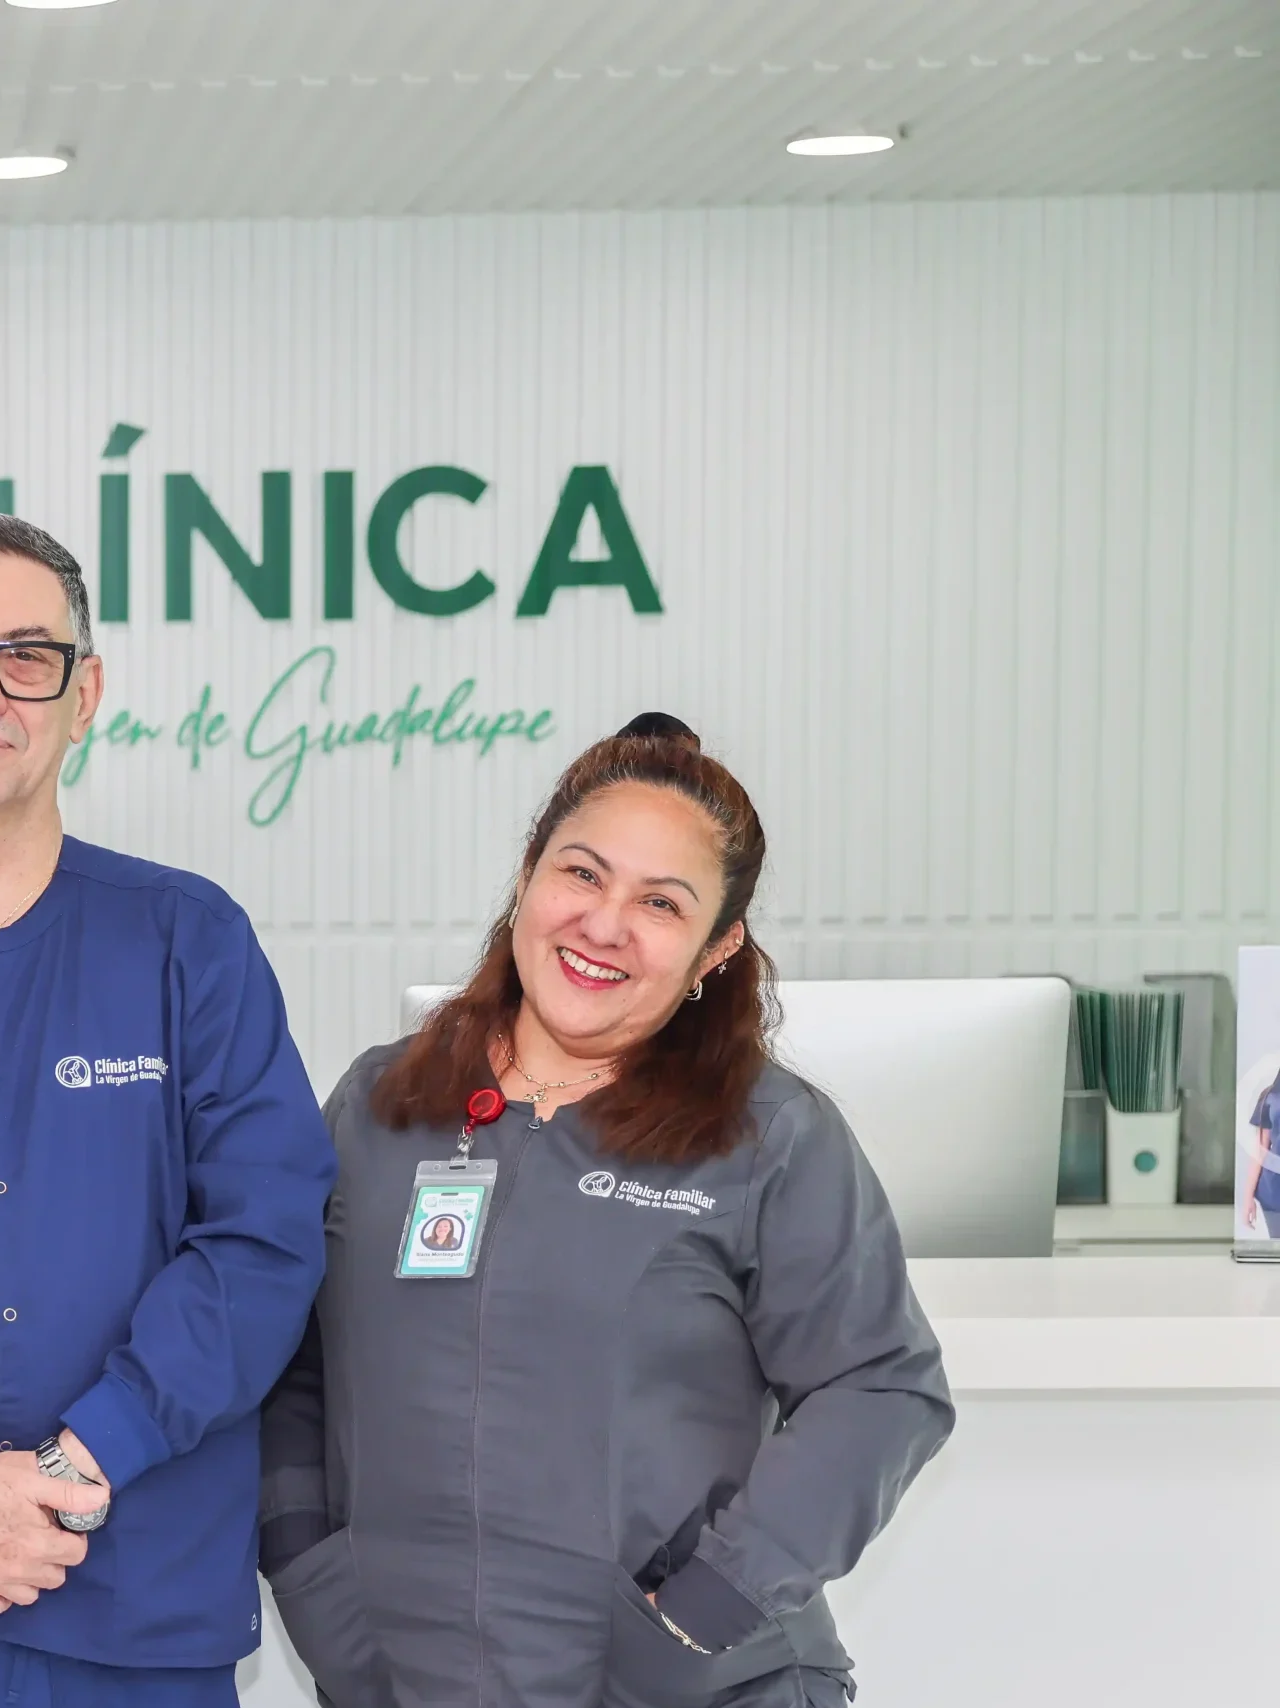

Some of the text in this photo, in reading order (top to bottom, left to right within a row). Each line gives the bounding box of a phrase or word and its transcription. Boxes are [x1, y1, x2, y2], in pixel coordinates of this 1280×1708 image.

[177, 683, 229, 769] de
[245, 645, 555, 826] Guadalupe
[95, 1058, 136, 1074] Clínica
[95, 1075, 104, 1084] La
[105, 1075, 128, 1086] Virgen
[130, 1073, 138, 1082] de
[614, 1191, 700, 1215] La Virgen de Guadalupe
[619, 1181, 716, 1210] Clínica Familiar
